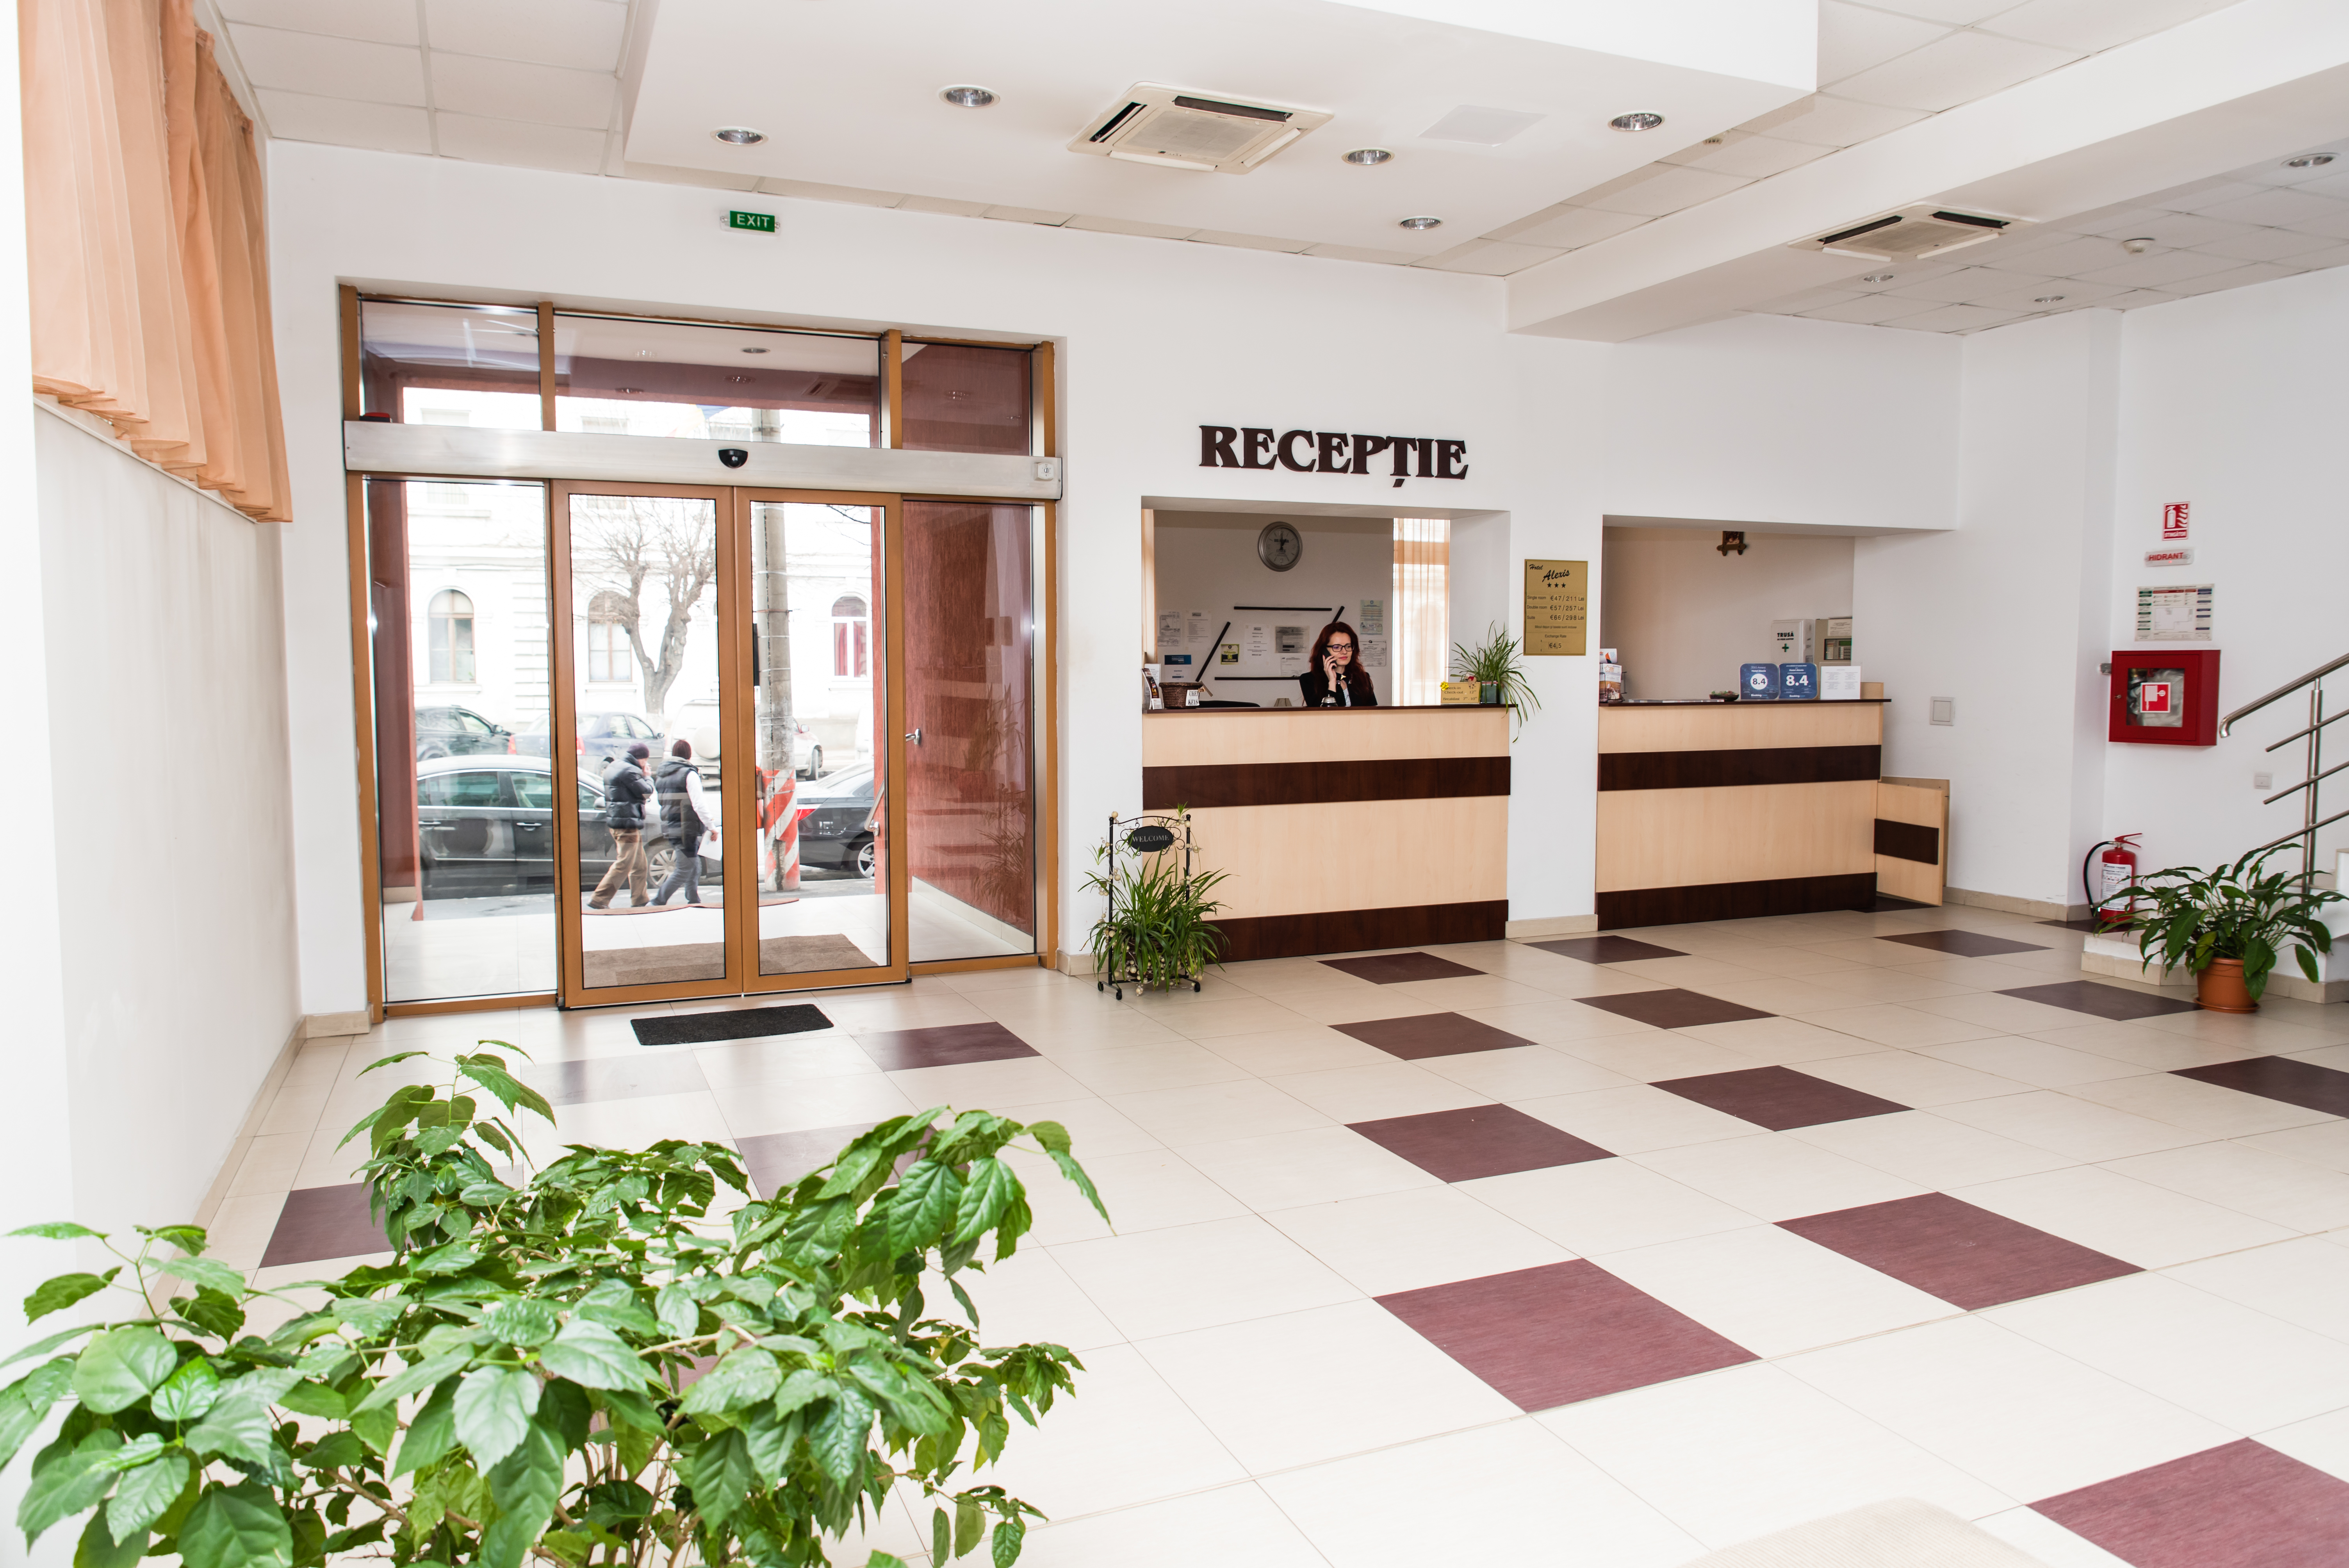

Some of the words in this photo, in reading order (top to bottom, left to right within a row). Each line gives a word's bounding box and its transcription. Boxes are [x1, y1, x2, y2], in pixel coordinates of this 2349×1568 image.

[737, 214, 770, 228] EXIT
[1199, 425, 1469, 488] RECEPȚIE
[2149, 552, 2184, 561] HIDRANT
[1542, 570, 1570, 582] Alexis
[1786, 675, 1809, 686] 8.4
